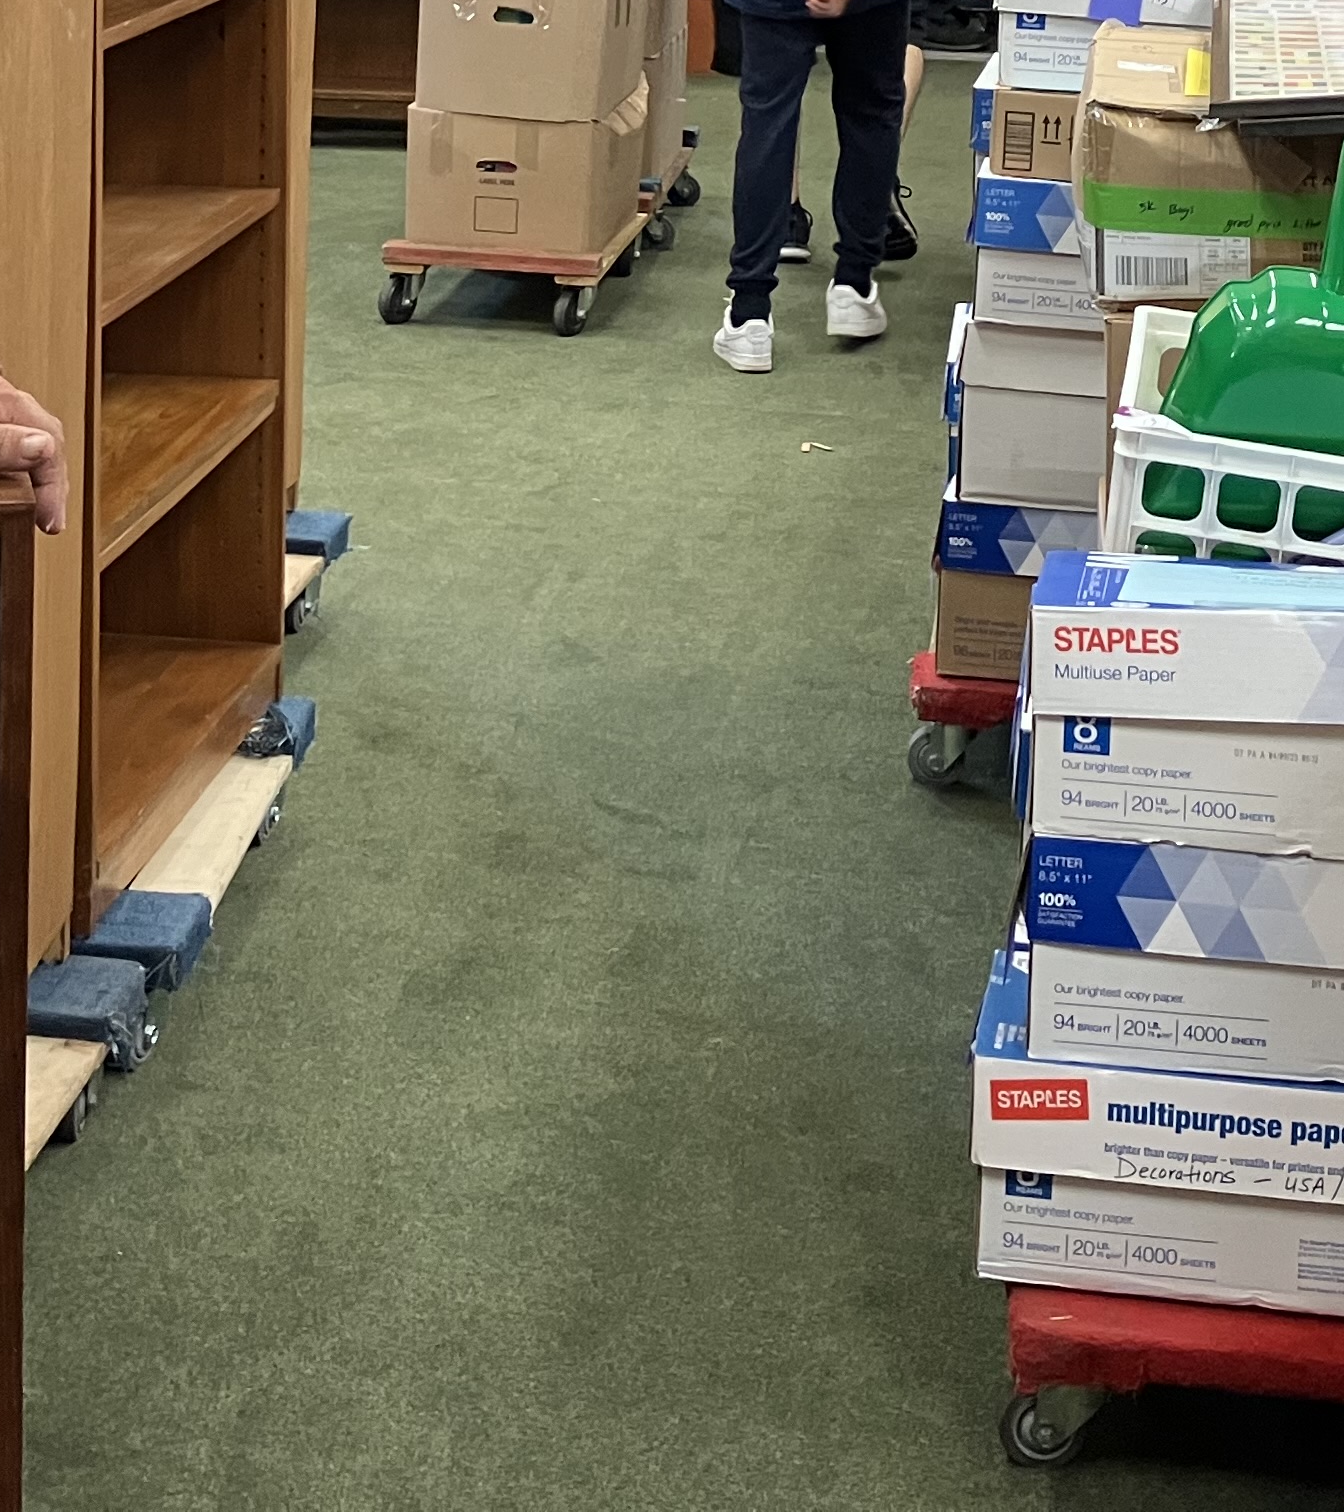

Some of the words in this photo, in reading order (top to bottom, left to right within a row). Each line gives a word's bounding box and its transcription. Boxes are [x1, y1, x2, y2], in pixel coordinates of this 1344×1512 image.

[1014, 51, 1027, 62] 94
[1058, 54, 1072, 65] 20
[986, 212, 1010, 222] 100%
[1037, 296, 1052, 307] 20
[948, 537, 973, 546] 100%
[1054, 626, 1179, 655] STAPLES
[1055, 663, 1122, 681] Multiuse
[1127, 665, 1176, 685] Paper
[1061, 759, 1081, 769] Our
[1084, 761, 1129, 774] brightest
[1132, 766, 1158, 778] copy
[1061, 789, 1082, 806] 94
[1131, 795, 1154, 812] 20
[1191, 801, 1236, 820] 4000
[1039, 855, 1083, 869] LETTER
[1038, 892, 1076, 906] 100%
[1054, 983, 1073, 994] Our
[1076, 985, 1121, 998] brightest
[1124, 990, 1151, 1002] copy
[1053, 1013, 1074, 1030] 94
[1123, 1019, 1146, 1036] 20
[1182, 1024, 1228, 1044] 4000
[997, 1089, 1082, 1109] STAPLES
[1107, 1101, 1282, 1139] multipurpose
[1104, 1143, 1141, 1155] brighter
[1144, 1147, 1164, 1158] than
[1167, 1151, 1189, 1163] copy
[1191, 1153, 1218, 1165] paper
[1272, 1160, 1286, 1170] for
[1288, 1162, 1325, 1174] printers
[1114, 1156, 1236, 1184] Decorations
[1003, 1201, 1022, 1213] Our
[1025, 1204, 1070, 1218] brightest
[1073, 1211, 1100, 1223] copy
[1003, 1232, 1024, 1249] 94
[1073, 1239, 1095, 1256] 20
[1132, 1246, 1178, 1265] 4000
